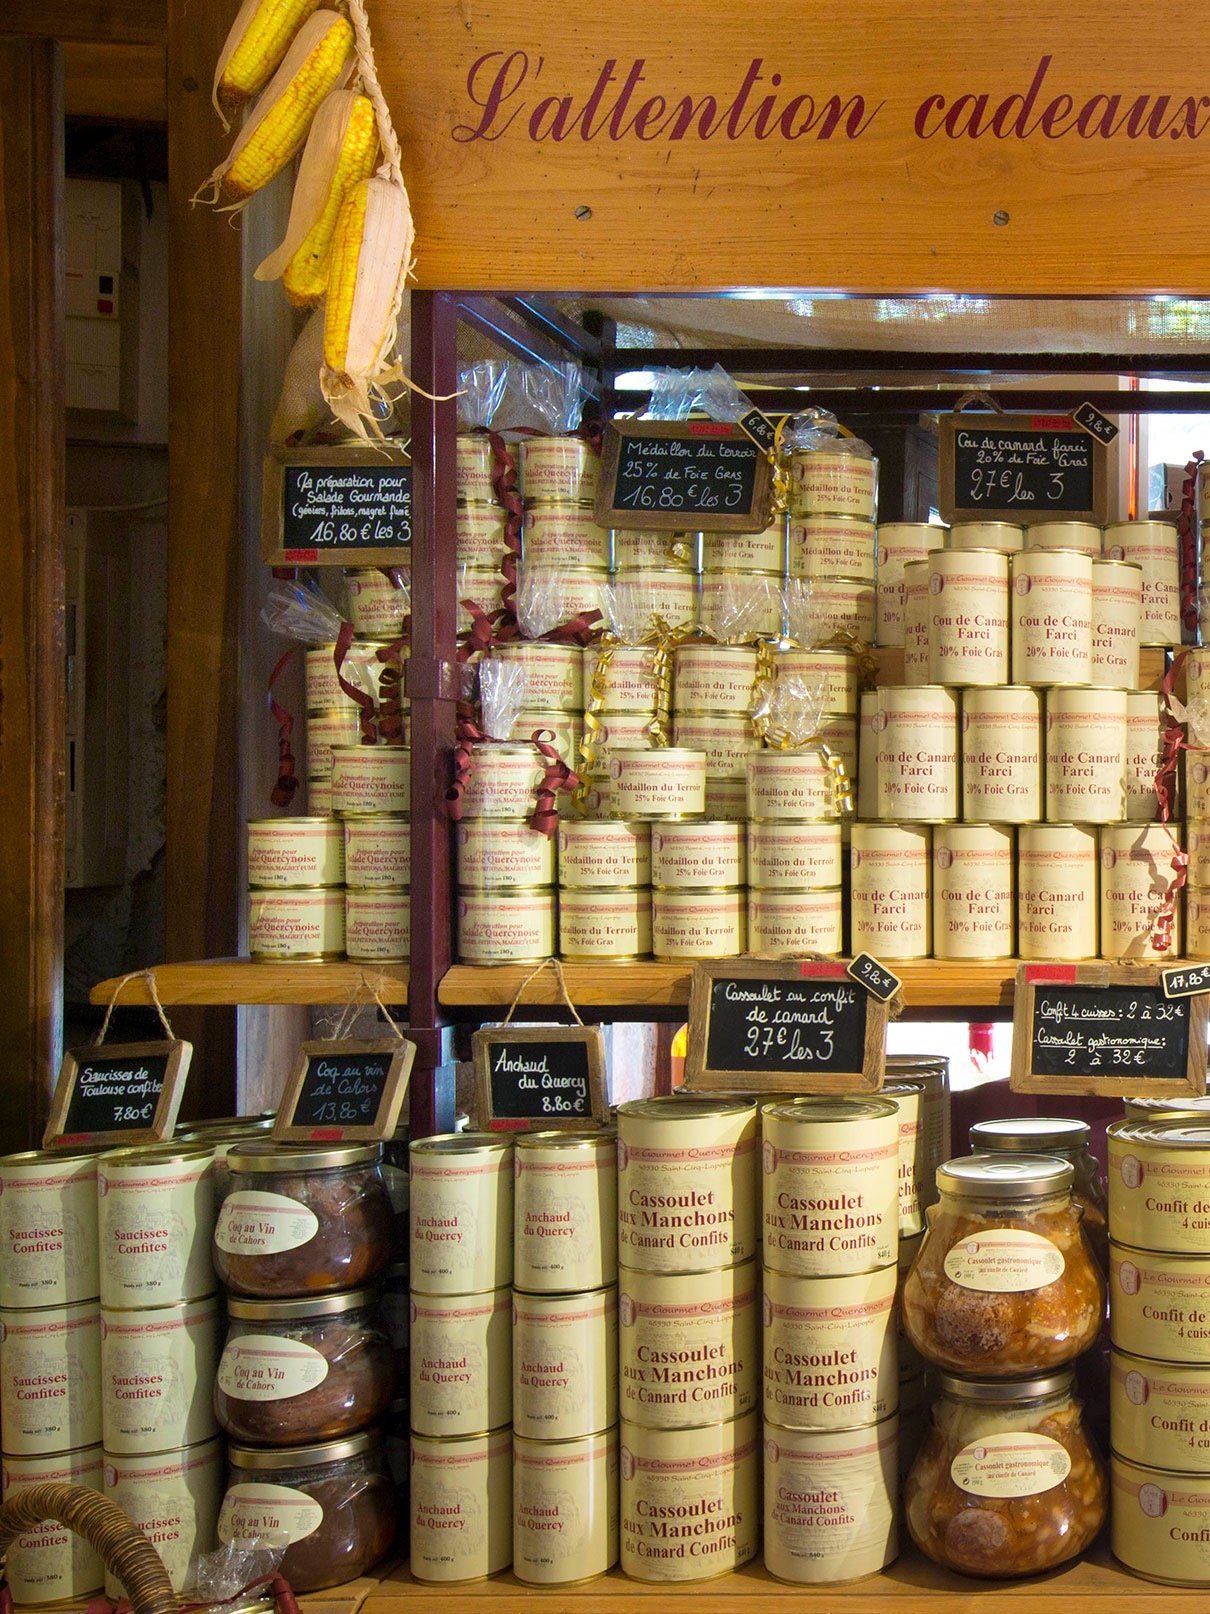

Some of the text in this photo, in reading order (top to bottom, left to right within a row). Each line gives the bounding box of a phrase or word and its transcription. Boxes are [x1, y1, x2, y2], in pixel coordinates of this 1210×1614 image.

[451, 50, 886, 142] L'attention
[627, 442, 757, 458] Médaillon du terroir
[958, 432, 1088, 460] Cou de canard farci
[976, 450, 1004, 464] 20%
[1008, 453, 1024, 464] de
[1058, 454, 1088, 467] Gras
[622, 461, 658, 478] 25%
[664, 469, 681, 480] de
[316, 475, 374, 492] préparation
[379, 478, 407, 493] pour
[970, 469, 1064, 502] 27€ les 3
[307, 489, 411, 503] Salade Gourmande
[696, 490, 718, 506] les
[726, 484, 743, 506] 3
[375, 520, 393, 539] les
[398, 521, 411, 541] 3
[933, 615, 952, 627] Cou
[956, 615, 970, 627] de
[958, 628, 990, 640] Farci
[939, 646, 1003, 658] 20% Foie Gras
[616, 782, 701, 792] Médaillon du Terroir
[634, 794, 684, 802] 25% Foie Gras
[488, 855, 541, 864] Quercynoise
[725, 982, 856, 1012] Cassoulet au confit
[745, 1007, 834, 1024] de canard
[1071, 1005, 1079, 1018] 4
[1126, 1002, 1137, 1019] 2
[1140, 1005, 1152, 1019] à
[1156, 1003, 1184, 1020] 32€
[744, 1026, 834, 1060] 27€ les 3
[494, 1049, 549, 1073] Anchaud
[1065, 1050, 1146, 1065] 2 à 32€
[81, 1067, 148, 1083] Saucisses de
[316, 1062, 384, 1081] Coq au vin
[80, 1084, 125, 1097] Toulouse
[311, 1079, 377, 1096] de Cahors
[519, 1074, 586, 1097] du Quercy
[113, 1103, 152, 1121] 7,80€
[1147, 1164, 1158, 1173] Le
[1161, 1164, 1206, 1175] Gourmet
[629, 1190, 715, 1208] Cassoulet
[1146, 1198, 1189, 1213] Confit
[1192, 1201, 1210, 1214] de
[525, 1212, 570, 1223] Anchaud
[619, 1208, 735, 1228] aux Manchons
[1182, 1218, 1189, 1229] 4
[114, 1228, 169, 1241] Saucisses
[227, 1221, 276, 1234] Coq au Vin
[524, 1225, 576, 1238] du Quercy
[229, 1234, 266, 1246] de Cahors
[630, 1232, 675, 1248] Canard
[679, 1230, 729, 1248] Confits
[118, 1241, 168, 1254] Confites
[967, 1257, 1042, 1267] Cassoulet gastronomique
